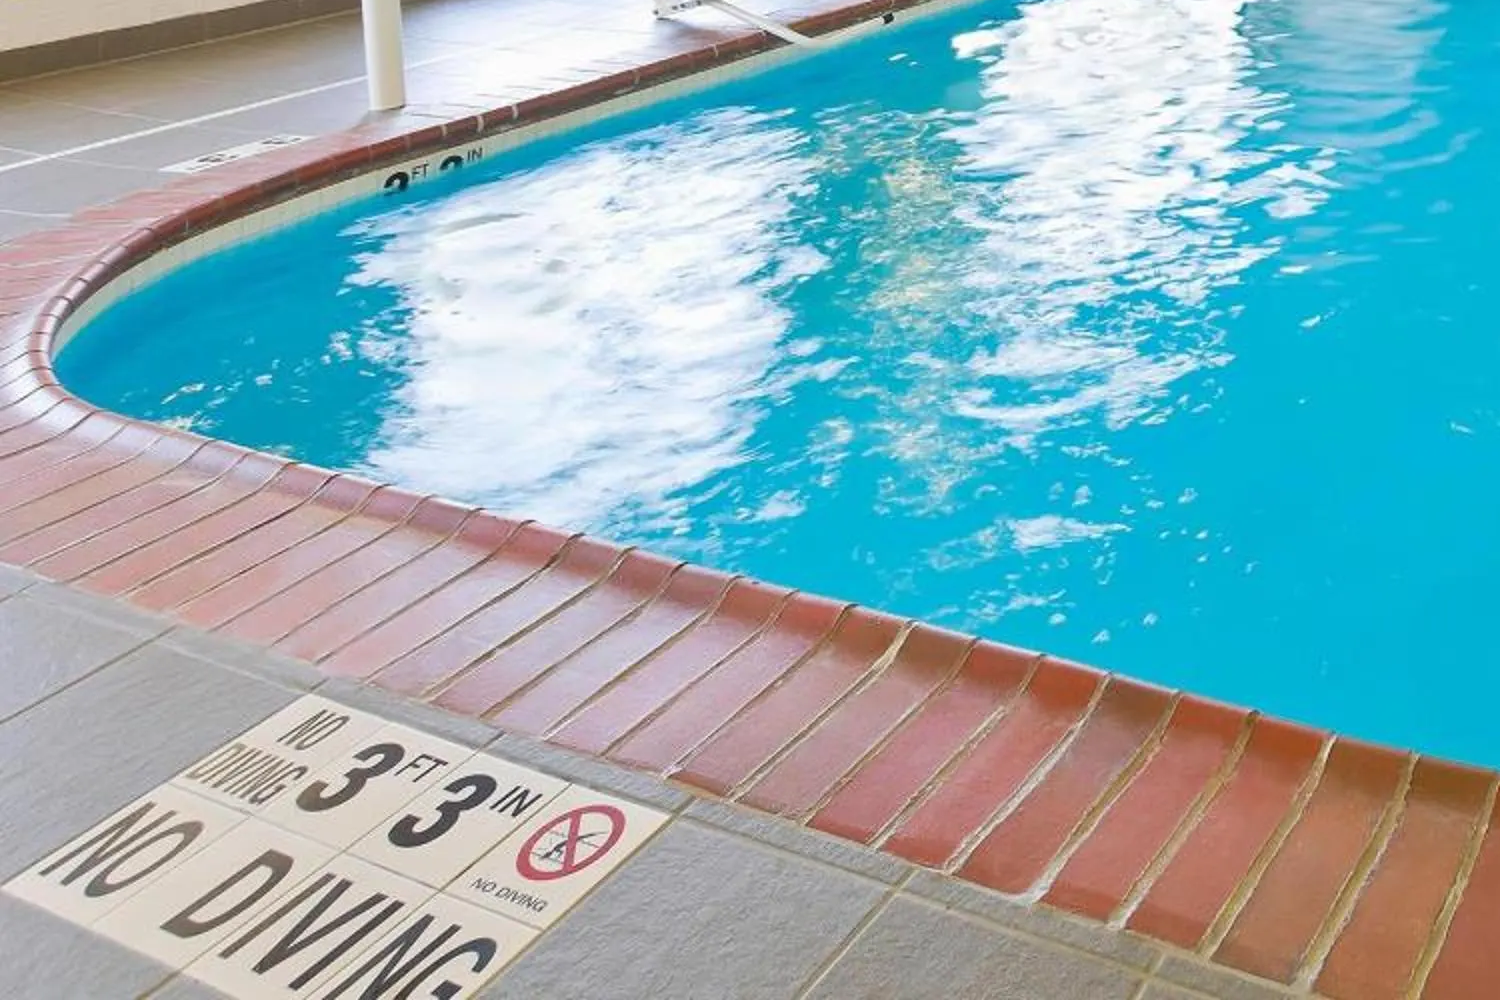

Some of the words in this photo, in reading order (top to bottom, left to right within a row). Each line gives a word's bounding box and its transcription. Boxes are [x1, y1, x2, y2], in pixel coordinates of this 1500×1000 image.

[412, 163, 429, 180] FT
[467, 147, 483, 161] IN
[276, 709, 350, 751] NO
[185, 743, 308, 805] DIVING
[295, 743, 406, 813] 3
[394, 753, 449, 783] FT
[388, 773, 497, 847] 3
[490, 786, 543, 817] IN
[38, 801, 204, 898] NO
[159, 848, 498, 1000] DIVING
[468, 877, 497, 893] NO
[495, 886, 549, 912] DIVING
